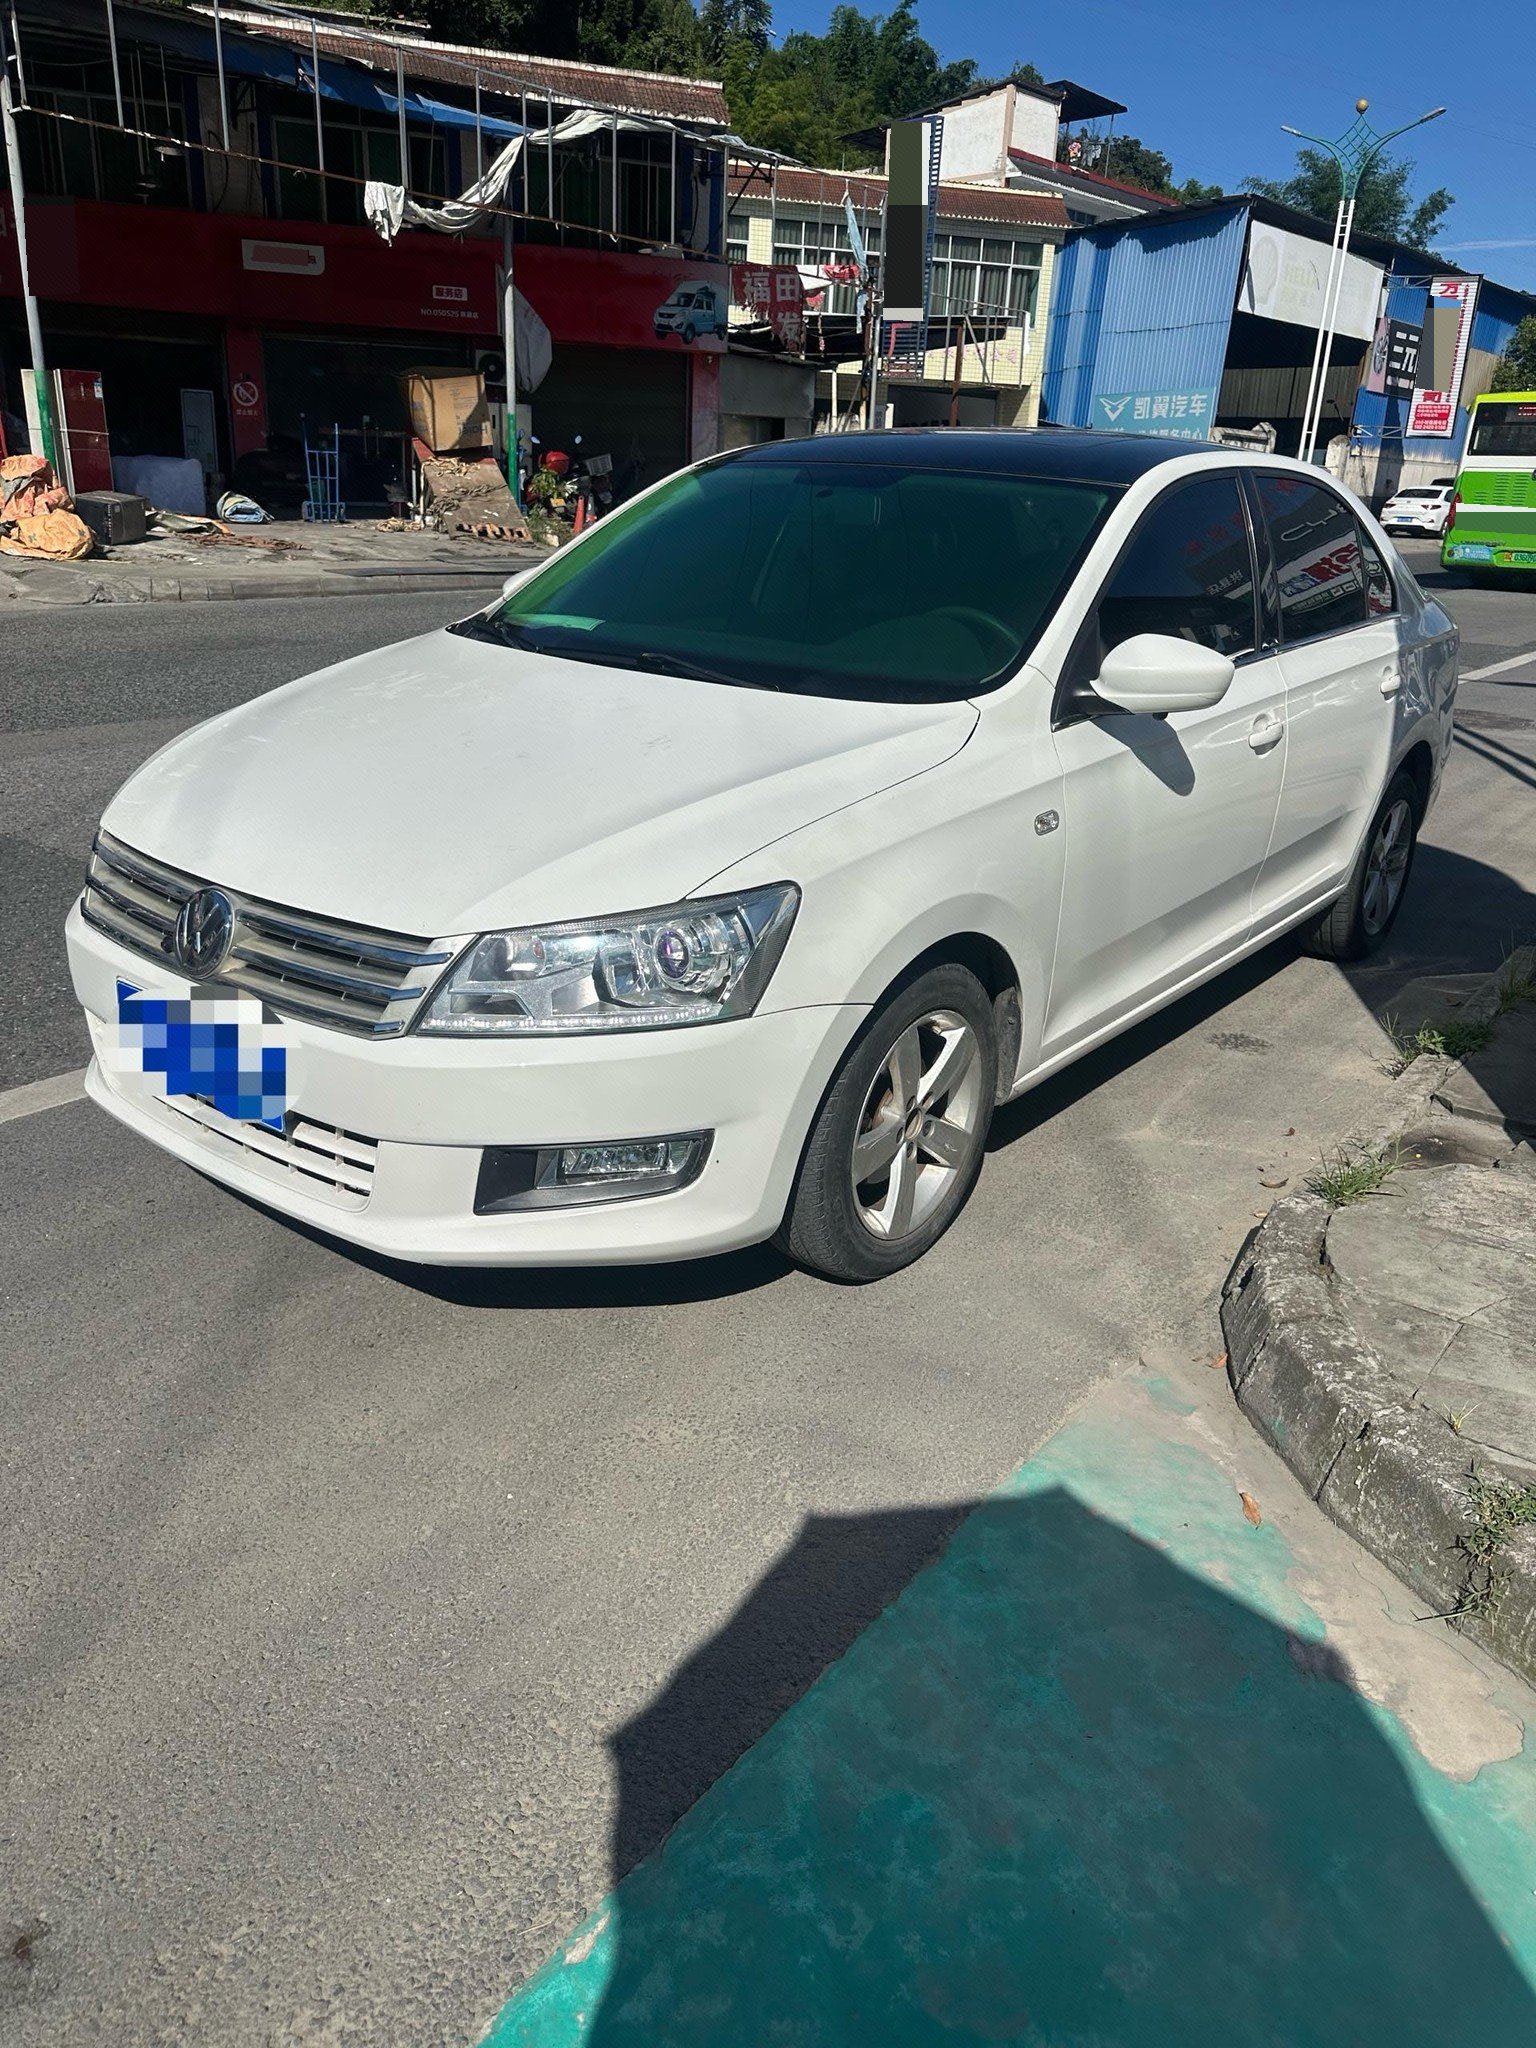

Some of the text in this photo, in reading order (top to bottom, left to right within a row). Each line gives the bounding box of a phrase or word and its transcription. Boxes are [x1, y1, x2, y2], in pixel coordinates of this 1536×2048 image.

[743, 270, 800, 302] 福田
[1133, 394, 1208, 420] 凯翼汽车
